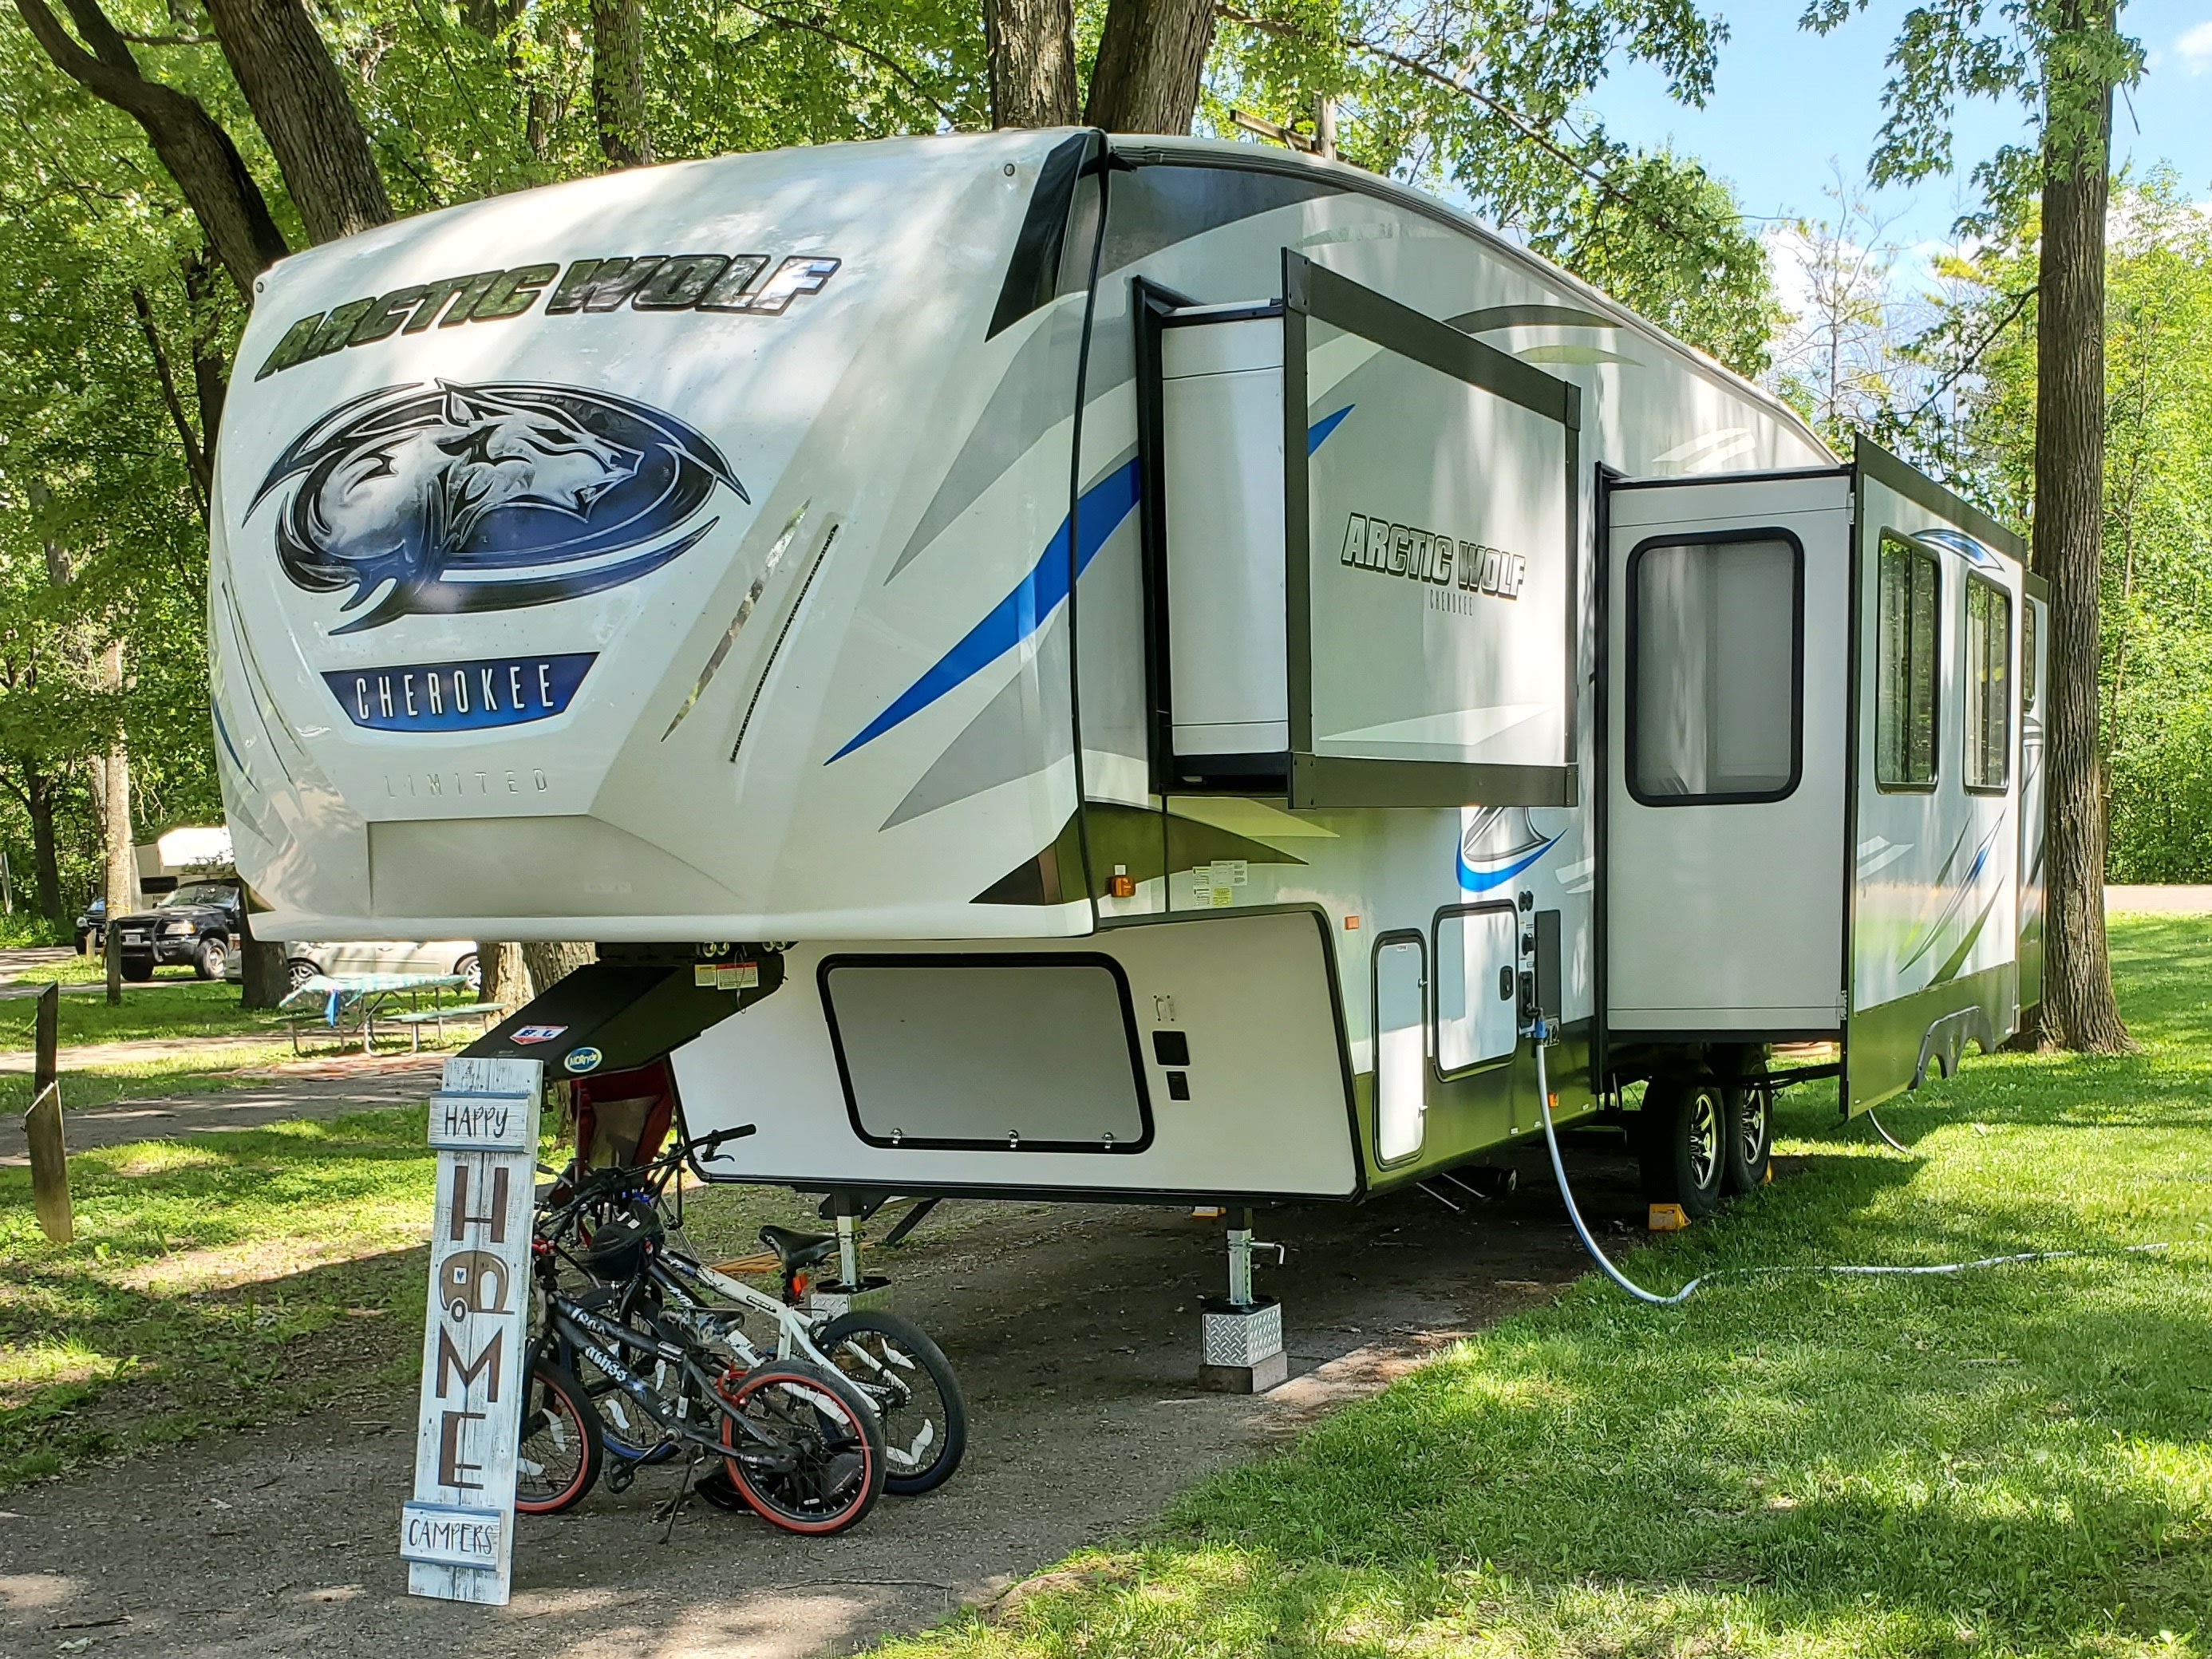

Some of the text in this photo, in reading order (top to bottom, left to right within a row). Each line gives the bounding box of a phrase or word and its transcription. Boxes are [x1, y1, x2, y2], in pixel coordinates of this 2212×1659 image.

[255, 254, 841, 381] ARCTIC WOLF
[1341, 512, 1526, 601] ARCTIC WOLF
[356, 664, 554, 720] CHEROKEE
[384, 768, 548, 798] LIMITED
[445, 1105, 508, 1139] HAPPY
[409, 1519, 493, 1554] CAMPERS
